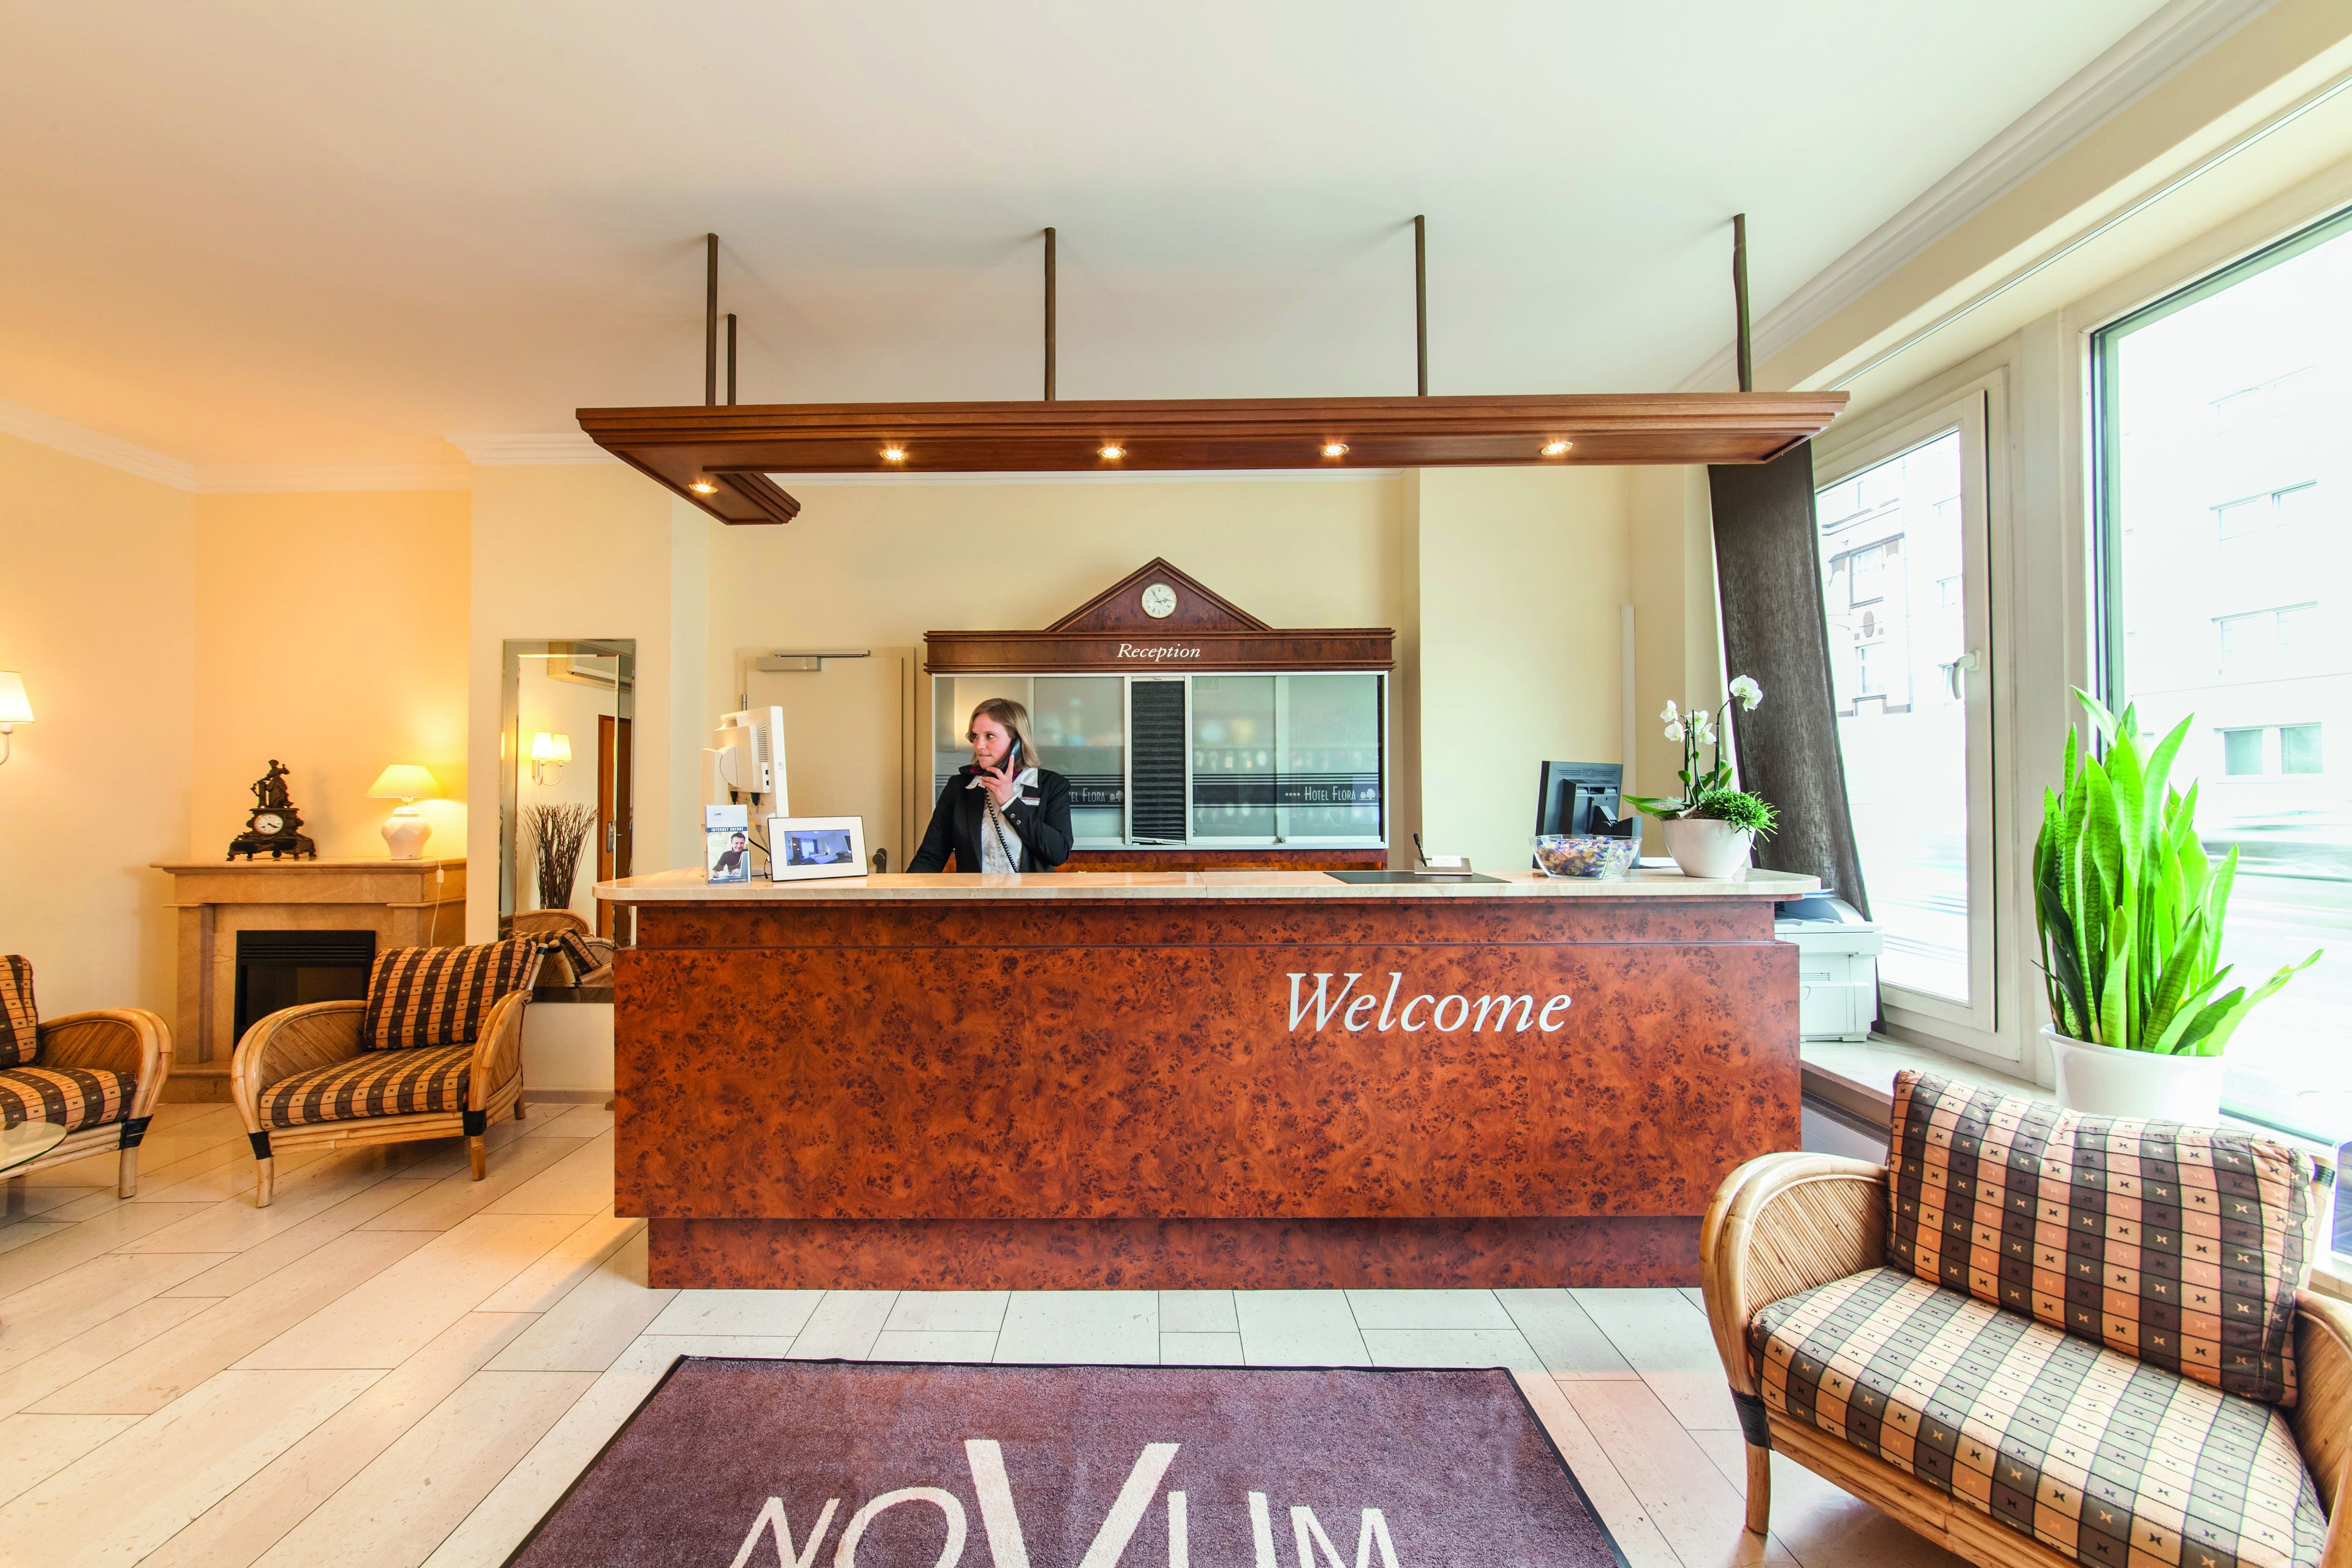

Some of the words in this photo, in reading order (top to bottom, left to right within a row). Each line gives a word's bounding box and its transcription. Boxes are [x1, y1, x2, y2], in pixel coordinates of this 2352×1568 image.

[1117, 643, 1200, 662] Reception
[1082, 788, 1106, 802] FLORA
[1304, 786, 1329, 801] HOTEL
[1332, 786, 1356, 801] FLORA
[1286, 972, 1572, 1033] Welcome
